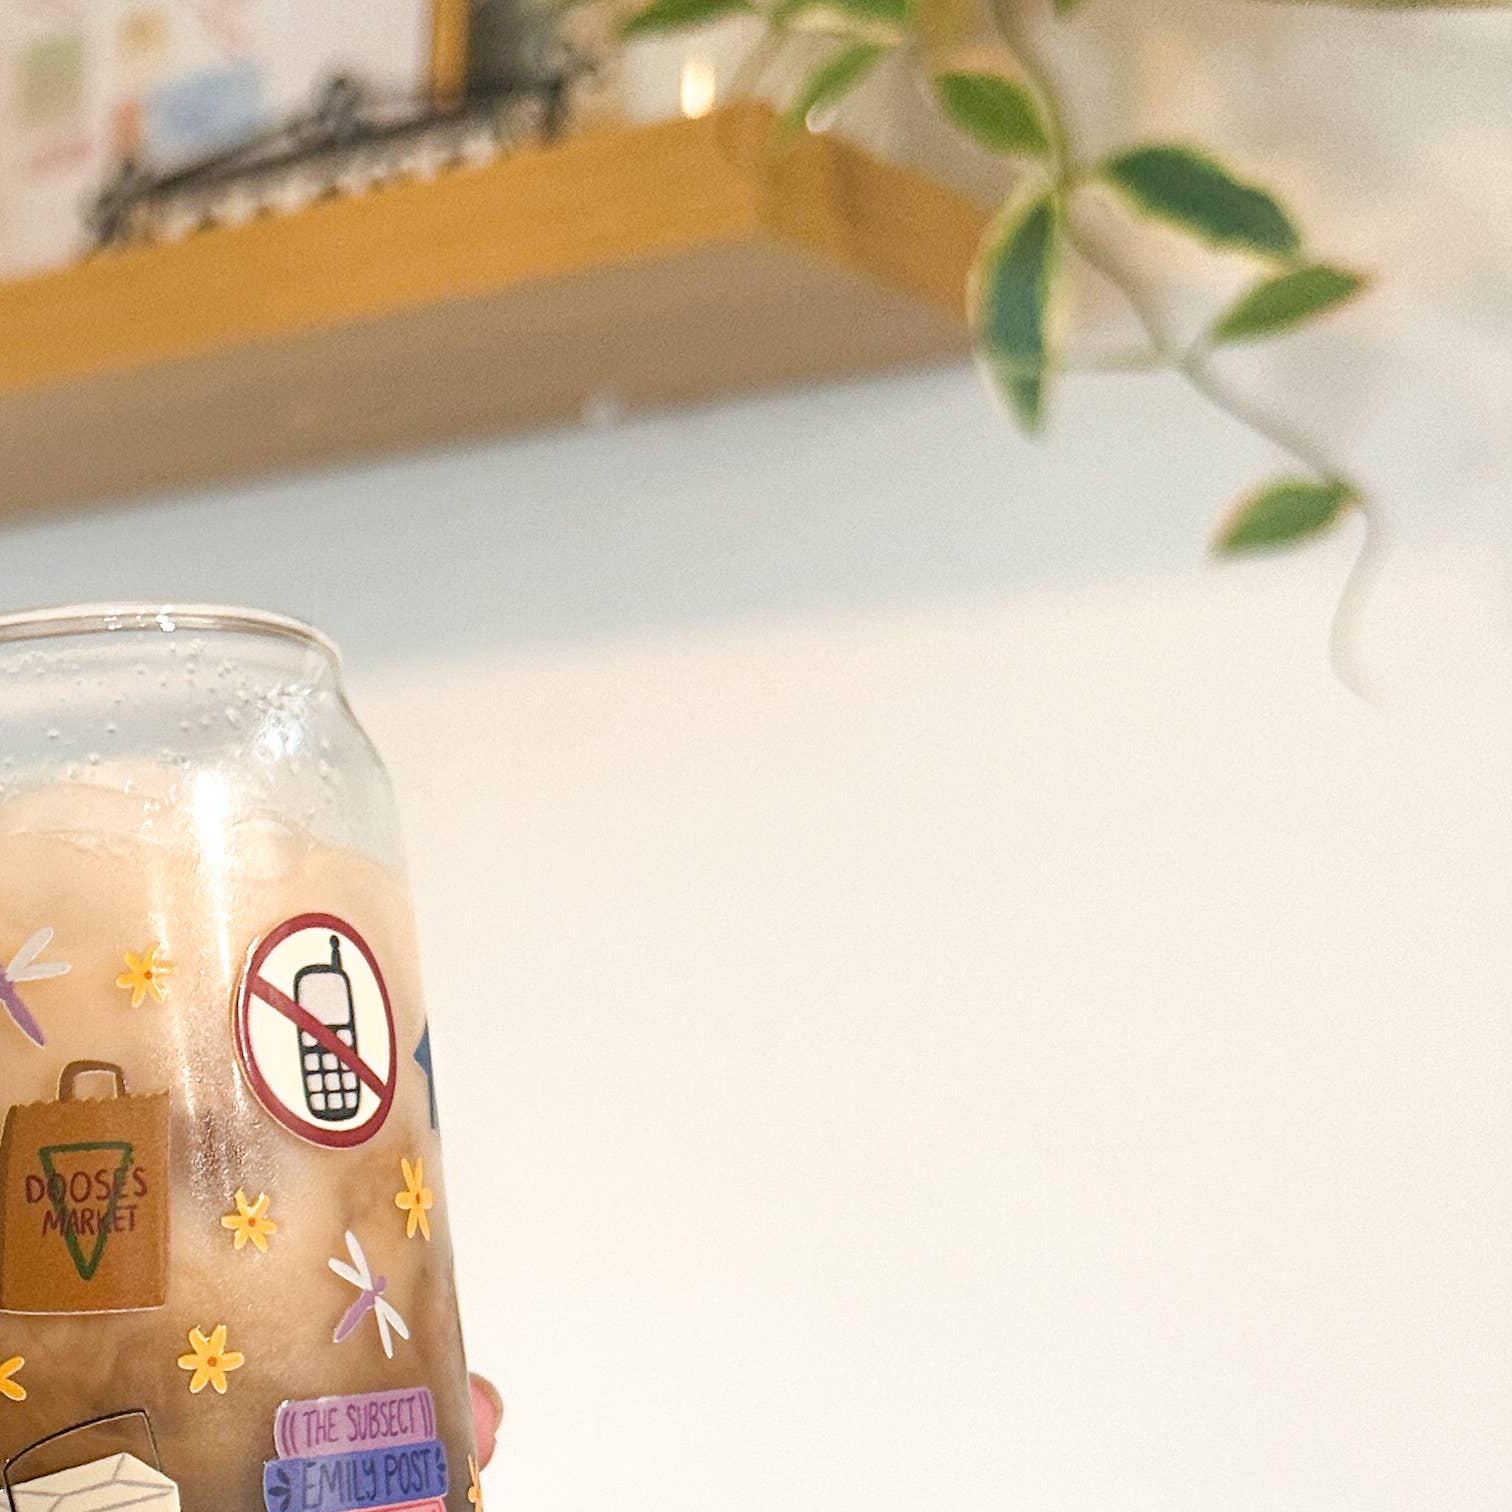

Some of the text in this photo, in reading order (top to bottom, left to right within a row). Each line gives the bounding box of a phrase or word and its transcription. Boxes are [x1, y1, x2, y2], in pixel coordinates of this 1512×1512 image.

[42, 1204, 137, 1237] MARKET
[304, 1397, 416, 1447] THE SUBSECT
[303, 1449, 431, 1511] EMILY POST
